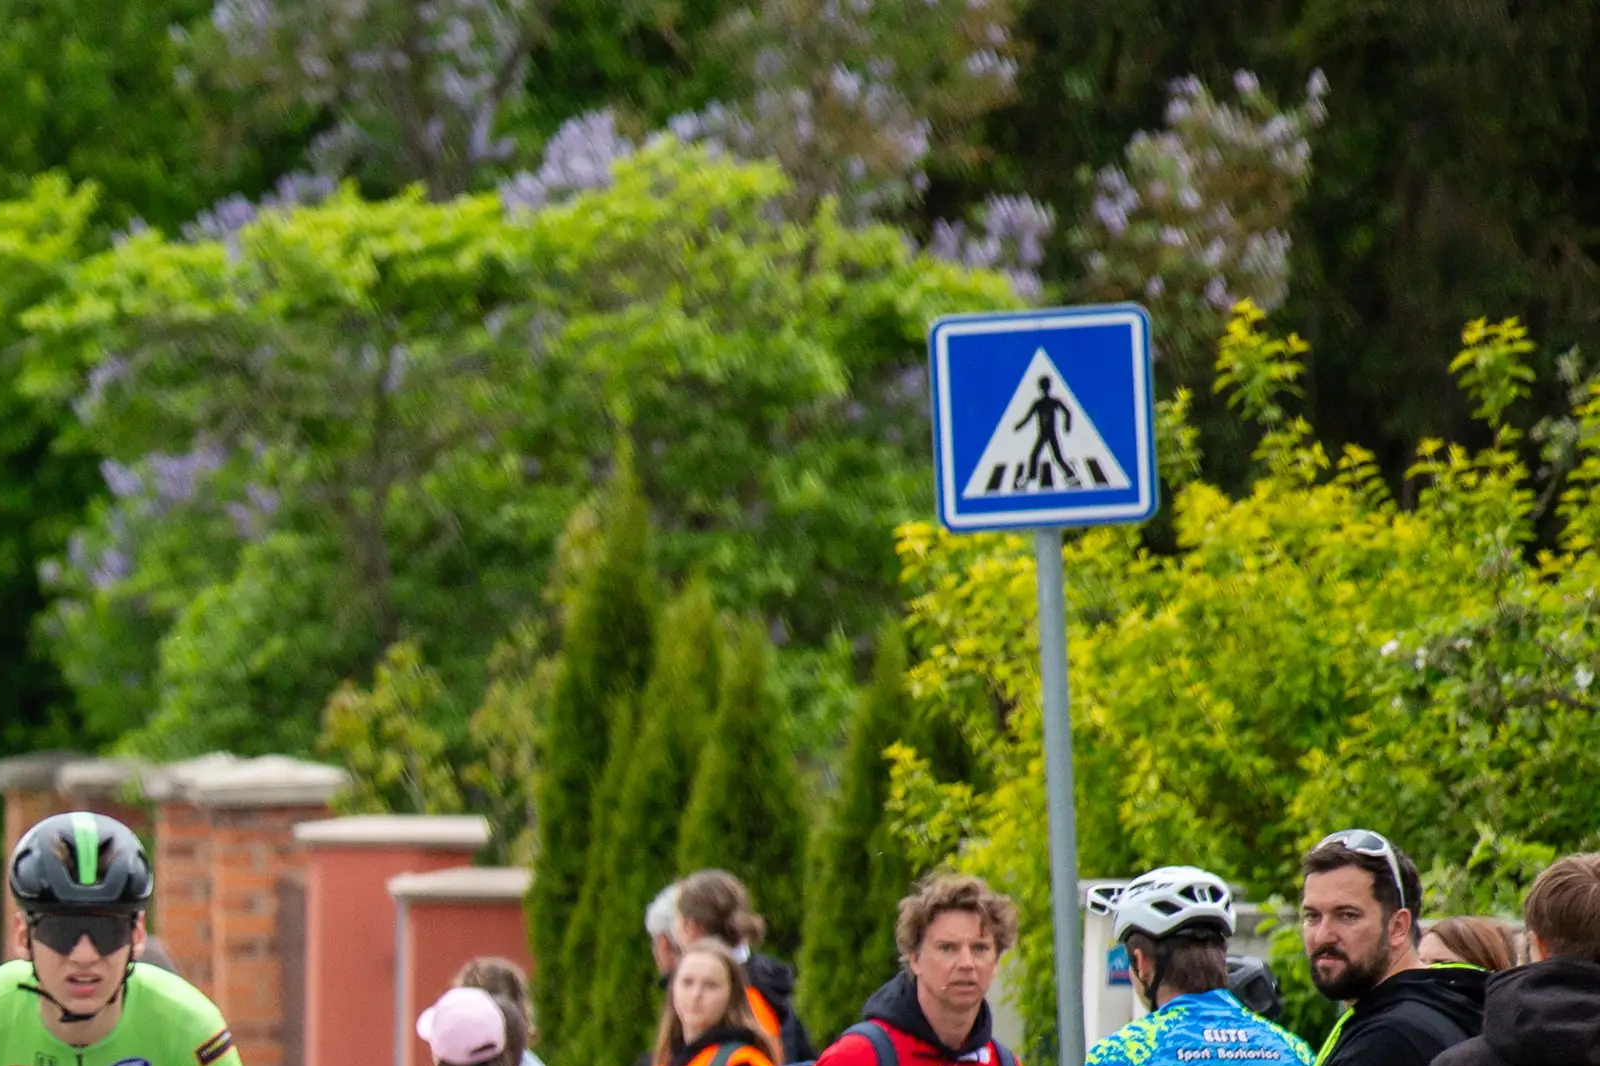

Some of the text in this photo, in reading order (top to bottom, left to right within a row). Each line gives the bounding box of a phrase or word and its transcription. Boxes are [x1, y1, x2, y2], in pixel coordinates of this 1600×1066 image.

[1203, 1028, 1249, 1043] ELITE
[1176, 1046, 1281, 1062] Sport Boskovice
